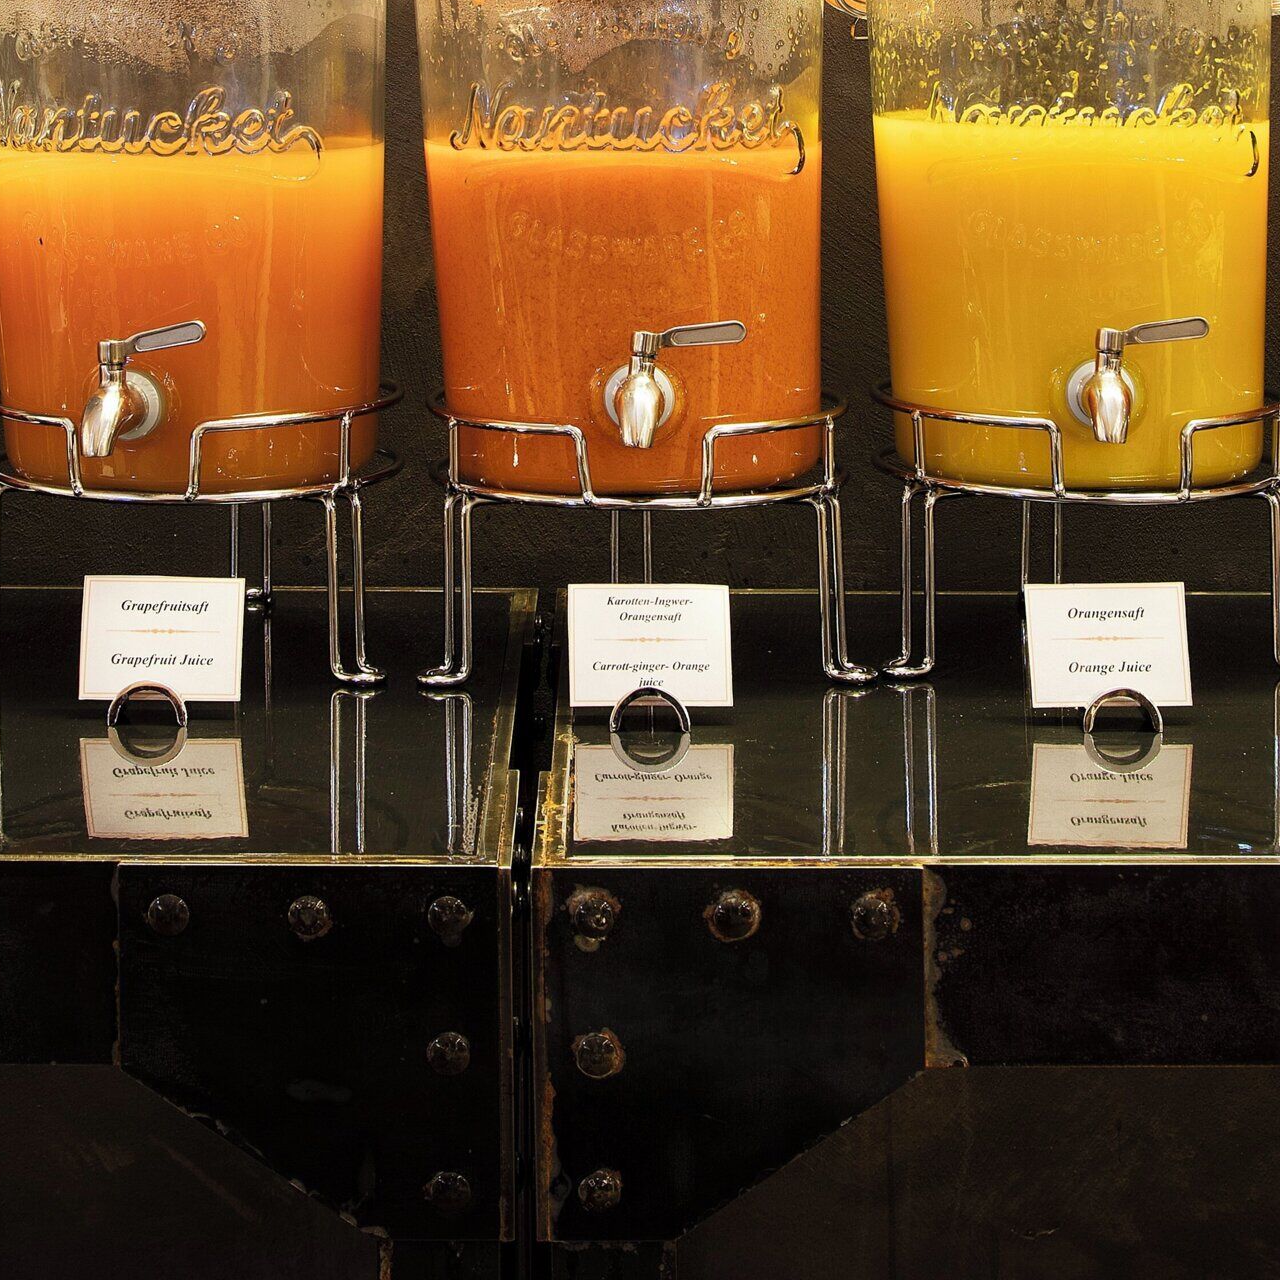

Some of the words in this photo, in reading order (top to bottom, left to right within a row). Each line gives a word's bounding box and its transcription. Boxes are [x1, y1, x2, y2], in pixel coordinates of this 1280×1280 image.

[120, 598, 210, 616] Grapefruitsaft
[606, 595, 694, 608] Karotten-Ingwer-
[619, 611, 682, 623] Orangensaft
[1067, 607, 1146, 621] Orangensaft
[110, 651, 177, 669] Grapefruit
[178, 651, 214, 667] Juice
[592, 660, 669, 673] Carrott-ginger-
[672, 661, 711, 673] Orange
[1068, 660, 1116, 675] Orange
[1118, 660, 1153, 674] Juice
[638, 677, 664, 688] juice
